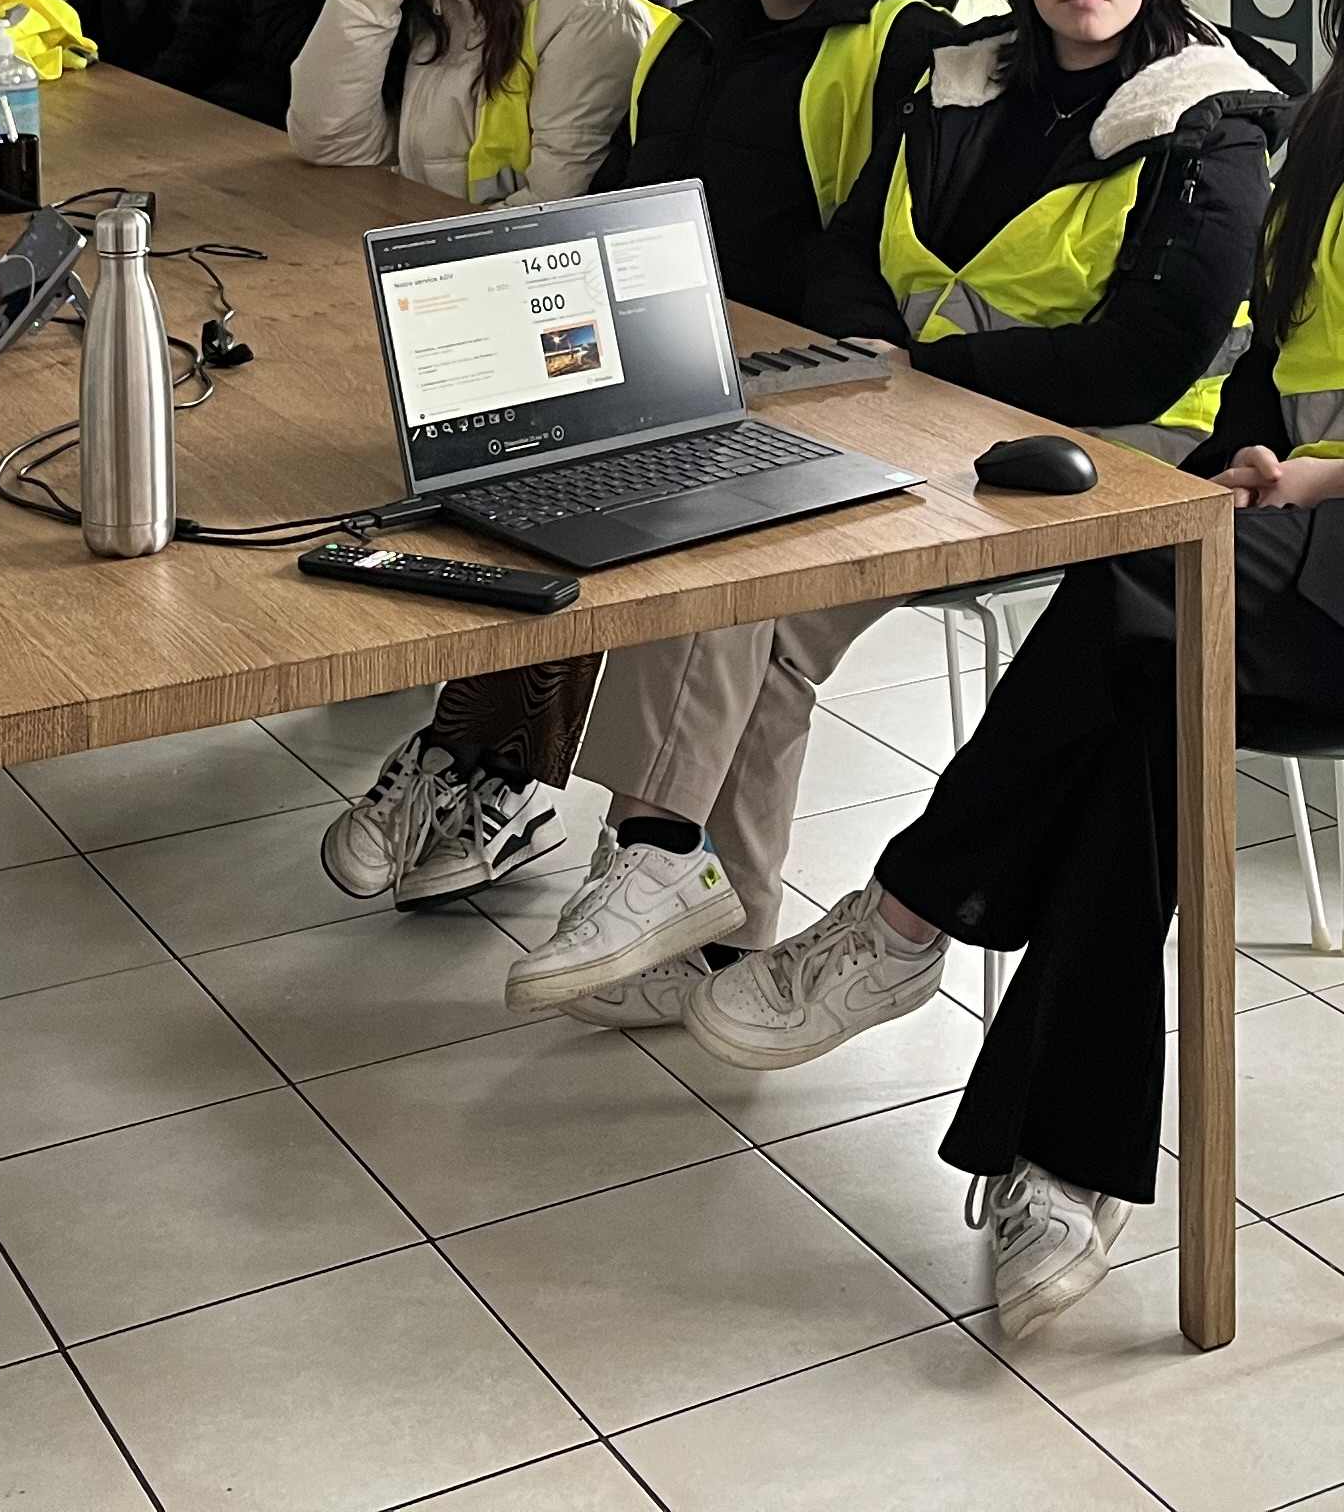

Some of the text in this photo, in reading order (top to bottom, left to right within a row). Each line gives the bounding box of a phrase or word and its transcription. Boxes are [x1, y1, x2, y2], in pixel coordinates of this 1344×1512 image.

[521, 250, 582, 275] 14 000
[530, 293, 566, 314] 800
